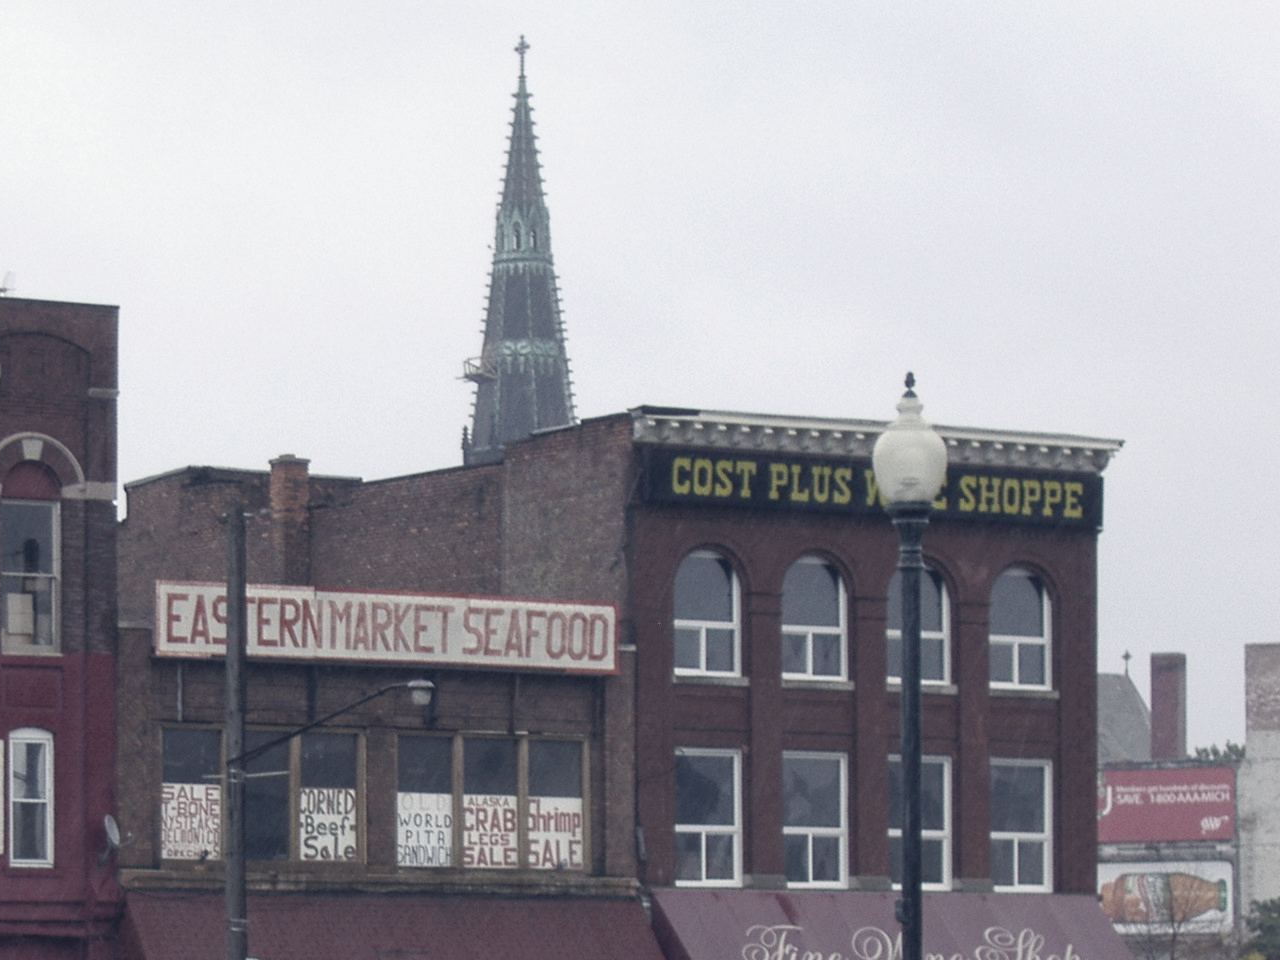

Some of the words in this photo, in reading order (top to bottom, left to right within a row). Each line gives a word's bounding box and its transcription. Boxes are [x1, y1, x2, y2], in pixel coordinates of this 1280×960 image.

[672, 457, 756, 499] COST
[769, 463, 853, 504] PLUS
[959, 475, 1084, 518] SHOPPE
[328, 599, 455, 655] MARKET
[463, 606, 609, 661] SEAFOOD
[162, 785, 220, 801] SALE
[300, 790, 356, 816] CORNED
[468, 796, 510, 807] ALASKA
[162, 801, 220, 817] T-BONE
[528, 798, 581, 837] Shrimp
[398, 813, 452, 829] WORLD
[464, 807, 517, 833] CRAB
[405, 830, 446, 844] PITA
[468, 833, 510, 846] LEGS
[304, 836, 355, 860] Sale
[464, 847, 518, 866] SALE
[529, 839, 582, 867] SALE
